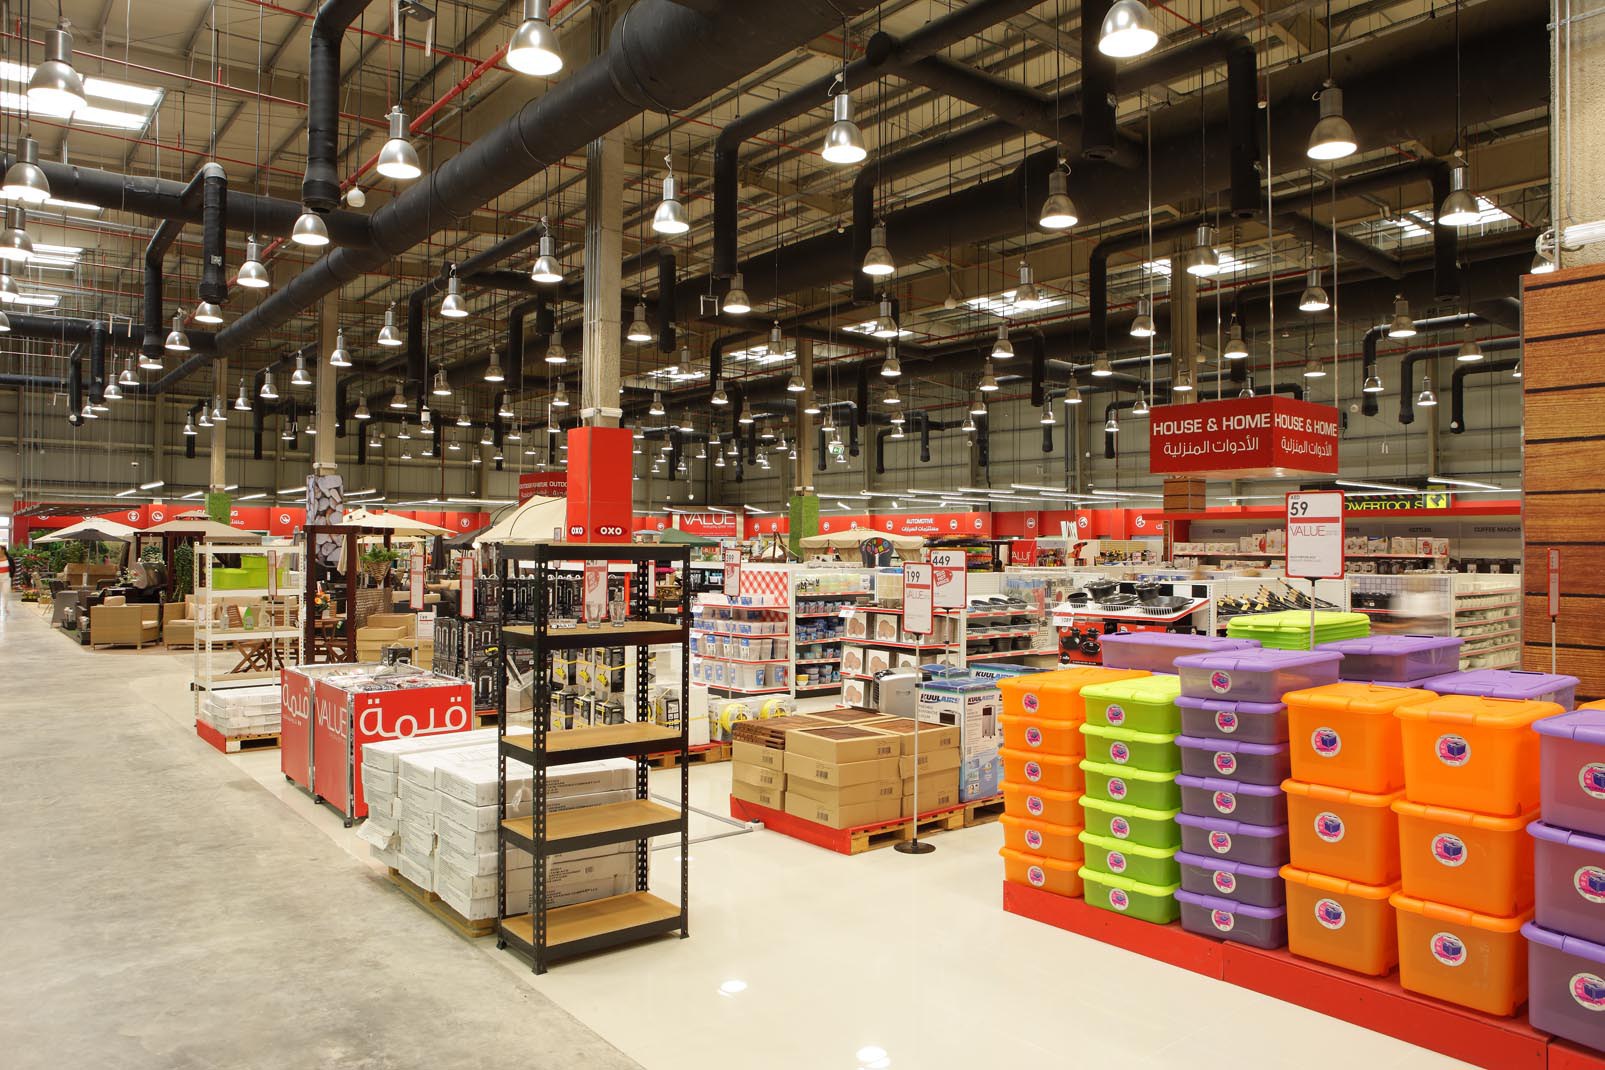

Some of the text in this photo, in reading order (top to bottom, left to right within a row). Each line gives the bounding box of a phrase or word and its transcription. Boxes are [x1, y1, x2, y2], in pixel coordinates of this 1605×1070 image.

[1153, 413, 1271, 436] HOUSE & HOME
[1274, 413, 1338, 437] HOUSE & HOME
[1163, 434, 1259, 458] الأدوات المنزلية
[1280, 436, 1332, 458] الأدوات المنزلية
[1290, 501, 1309, 516] 59
[683, 512, 736, 525] VALUE
[571, 526, 584, 535] OXO
[600, 526, 623, 536] OXO
[1290, 525, 1326, 537] VALUE
[933, 555, 951, 565] 449
[906, 570, 921, 583] 199
[314, 696, 347, 739] VALUE
